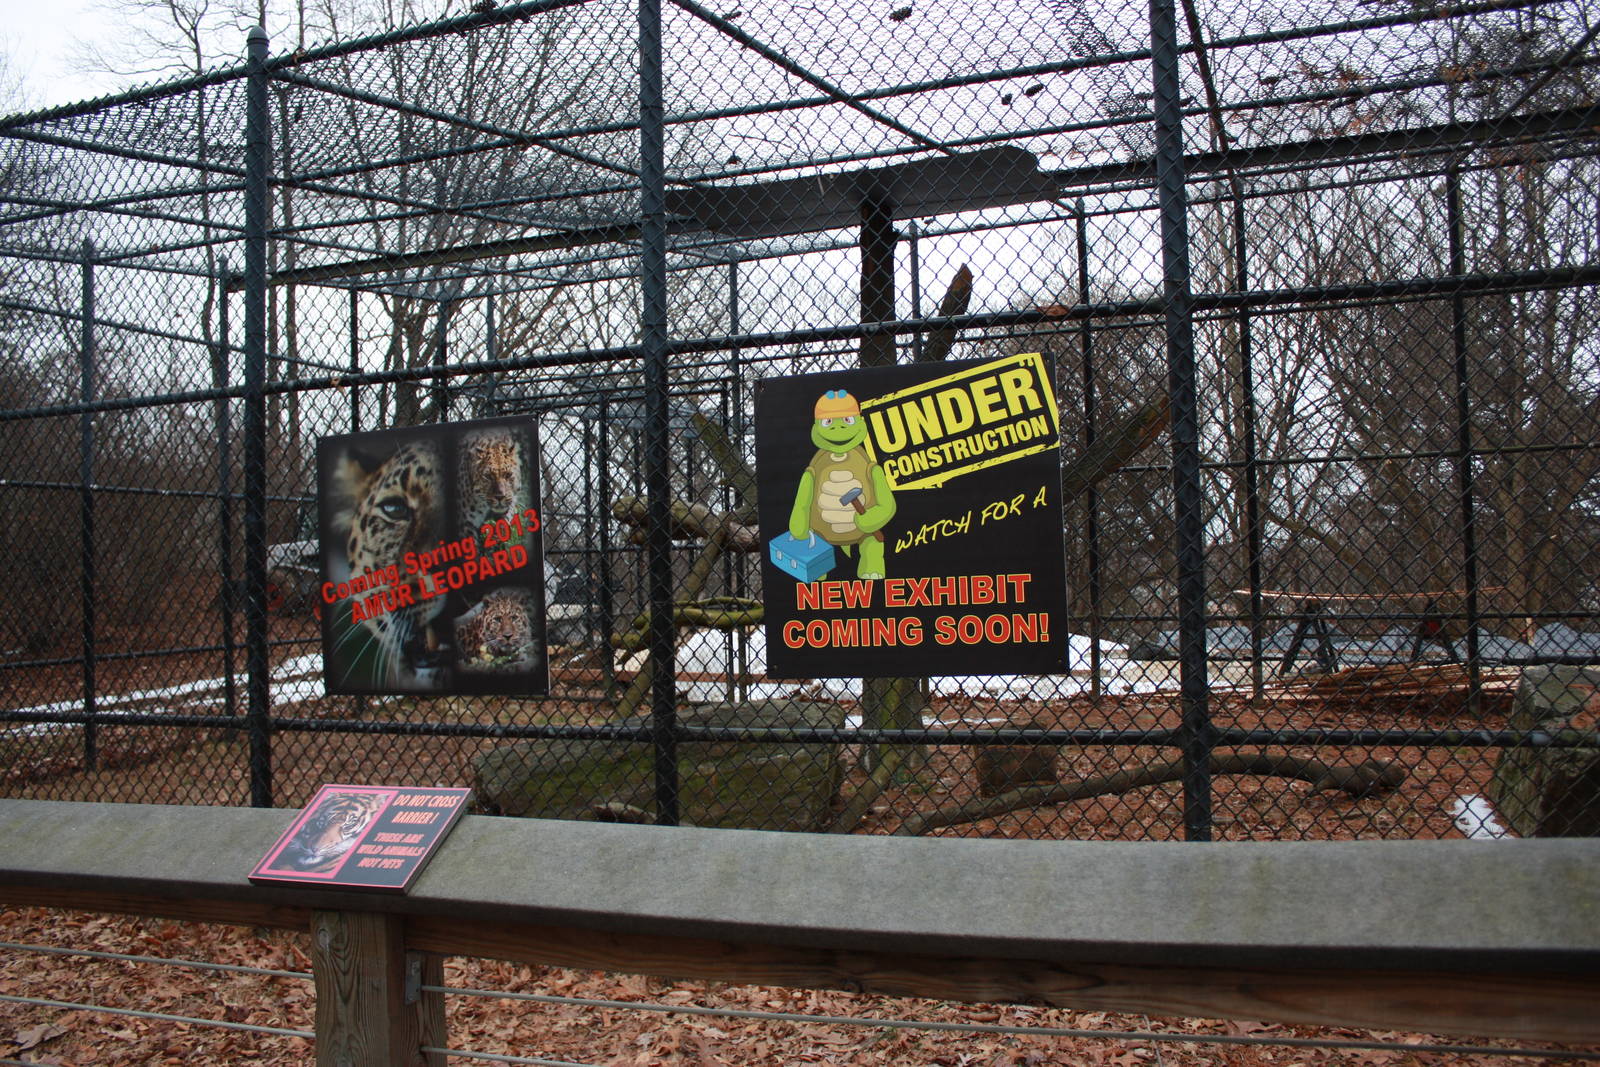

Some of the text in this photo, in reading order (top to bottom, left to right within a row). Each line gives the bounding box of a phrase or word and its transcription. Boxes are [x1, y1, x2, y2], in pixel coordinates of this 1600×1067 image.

[870, 368, 1043, 454] UNDER
[883, 414, 1050, 480] CONSTRUCTION
[895, 486, 1048, 553] WATCH FOR A
[321, 508, 540, 604] Coming Spring 2013
[352, 545, 528, 625] AMUR LEOPARD
[796, 573, 1031, 611] NEW EXHIBIT
[783, 613, 1050, 649] COMING SOON!
[392, 794, 461, 808] DO NOT CROSS
[356, 844, 426, 856] WILD ANIMALS
[374, 832, 425, 844] THESE ARE
[357, 857, 406, 869] NOT PETS
